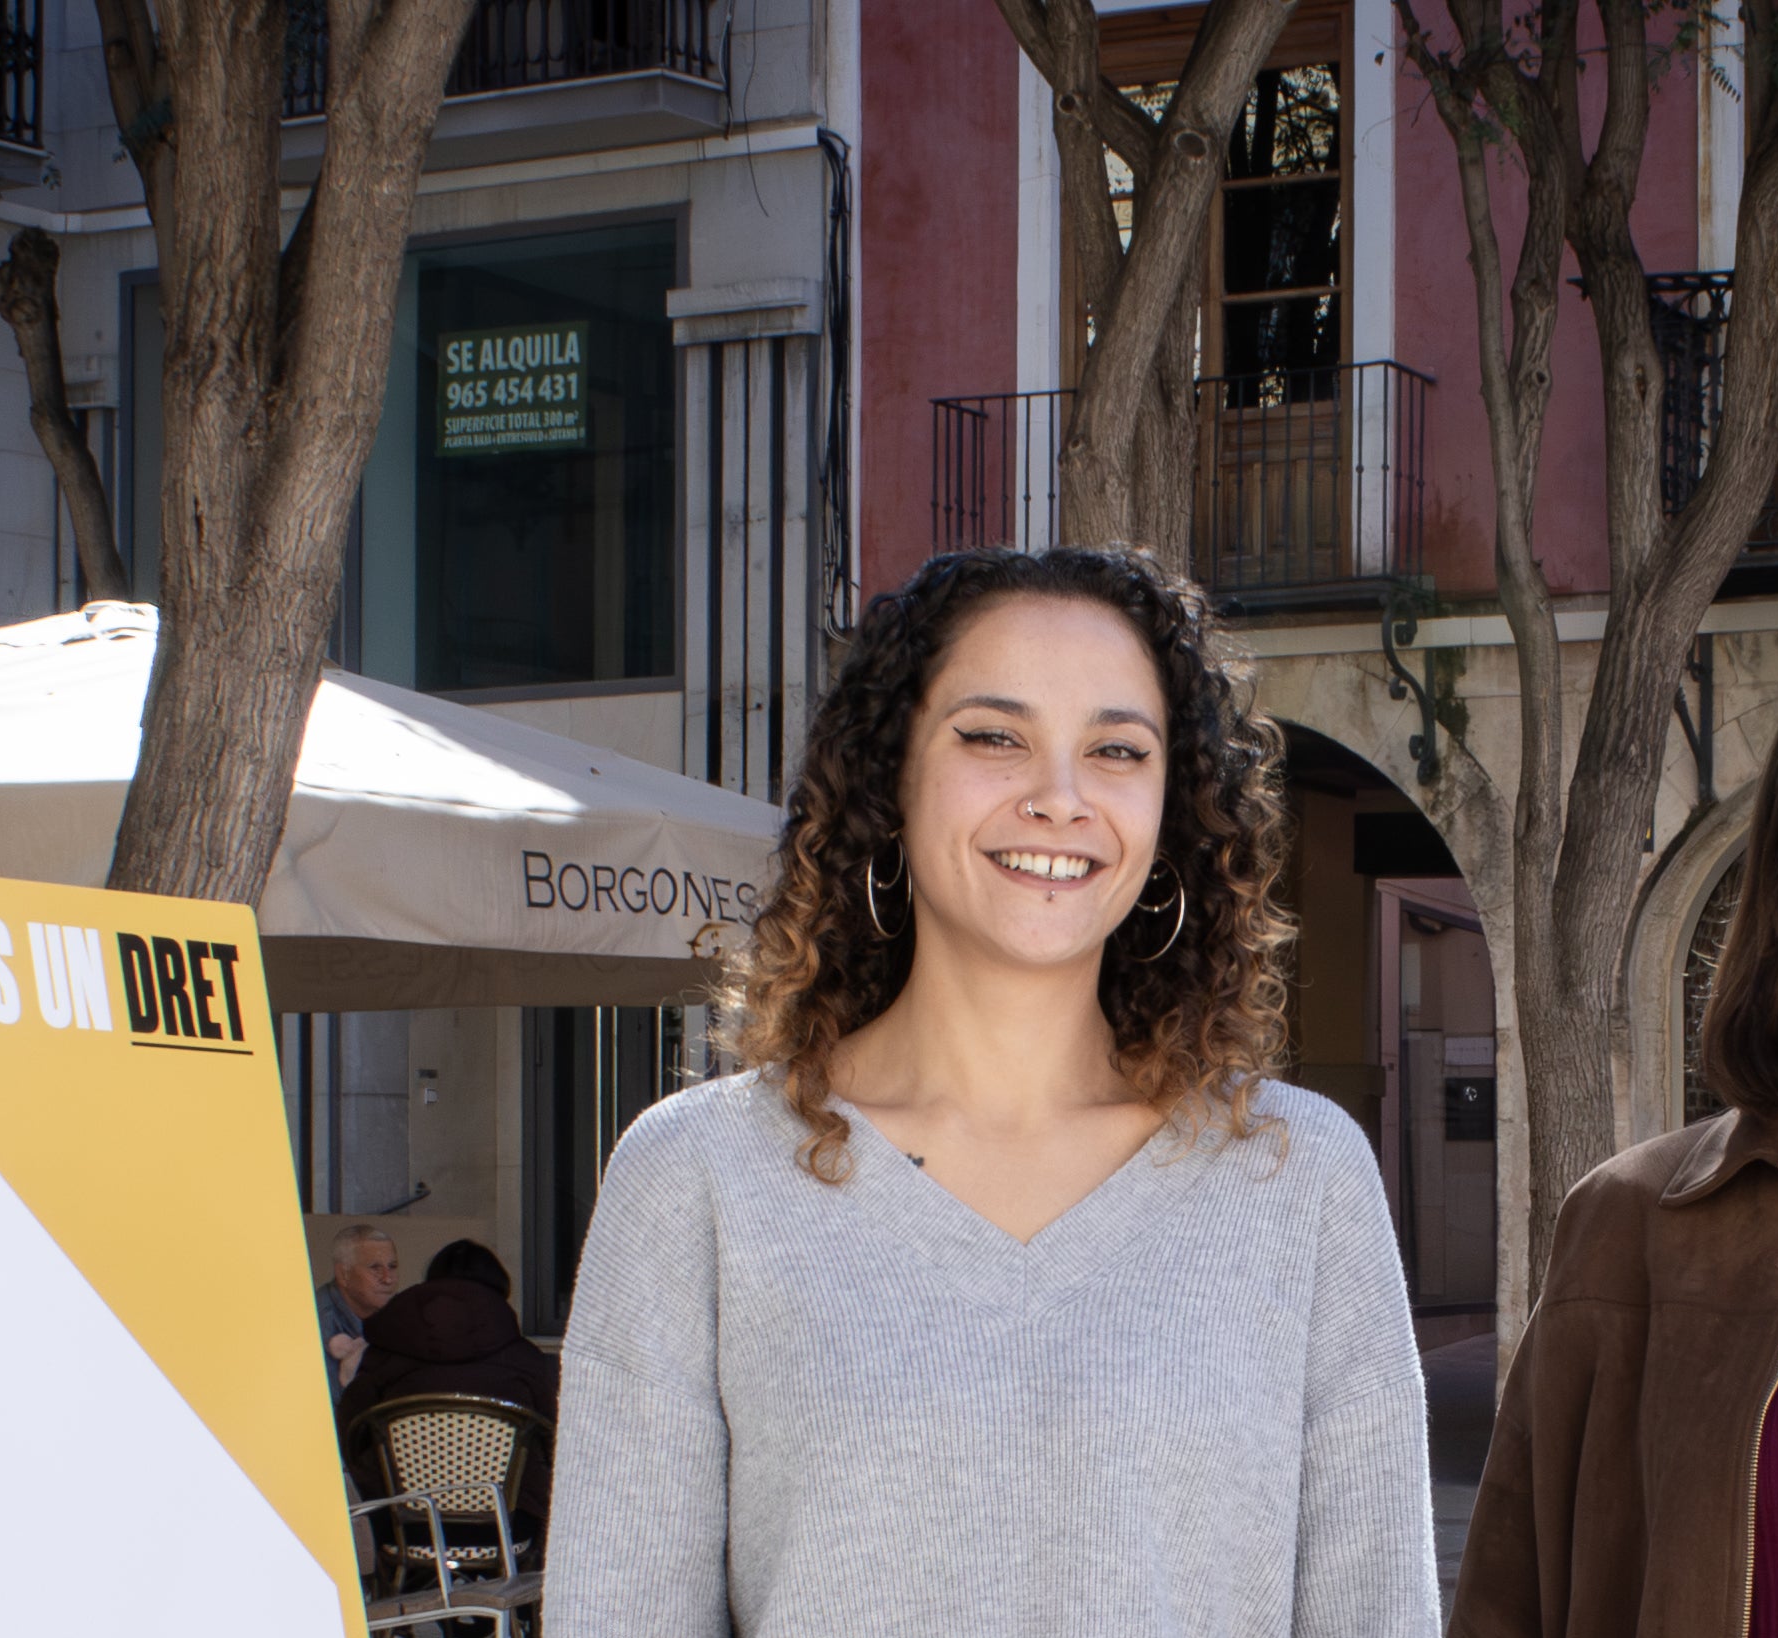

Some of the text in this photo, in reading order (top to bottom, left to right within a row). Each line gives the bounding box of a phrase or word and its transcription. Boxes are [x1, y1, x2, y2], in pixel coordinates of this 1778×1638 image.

[446, 331, 580, 374] SE ALQUILA
[446, 372, 578, 410] 965 454 431
[444, 413, 506, 434] SUPERFICIE
[508, 410, 542, 431] TOTAL
[522, 849, 761, 928] BORGONES
[26, 921, 114, 1032] UN
[116, 931, 246, 1042] DRET
